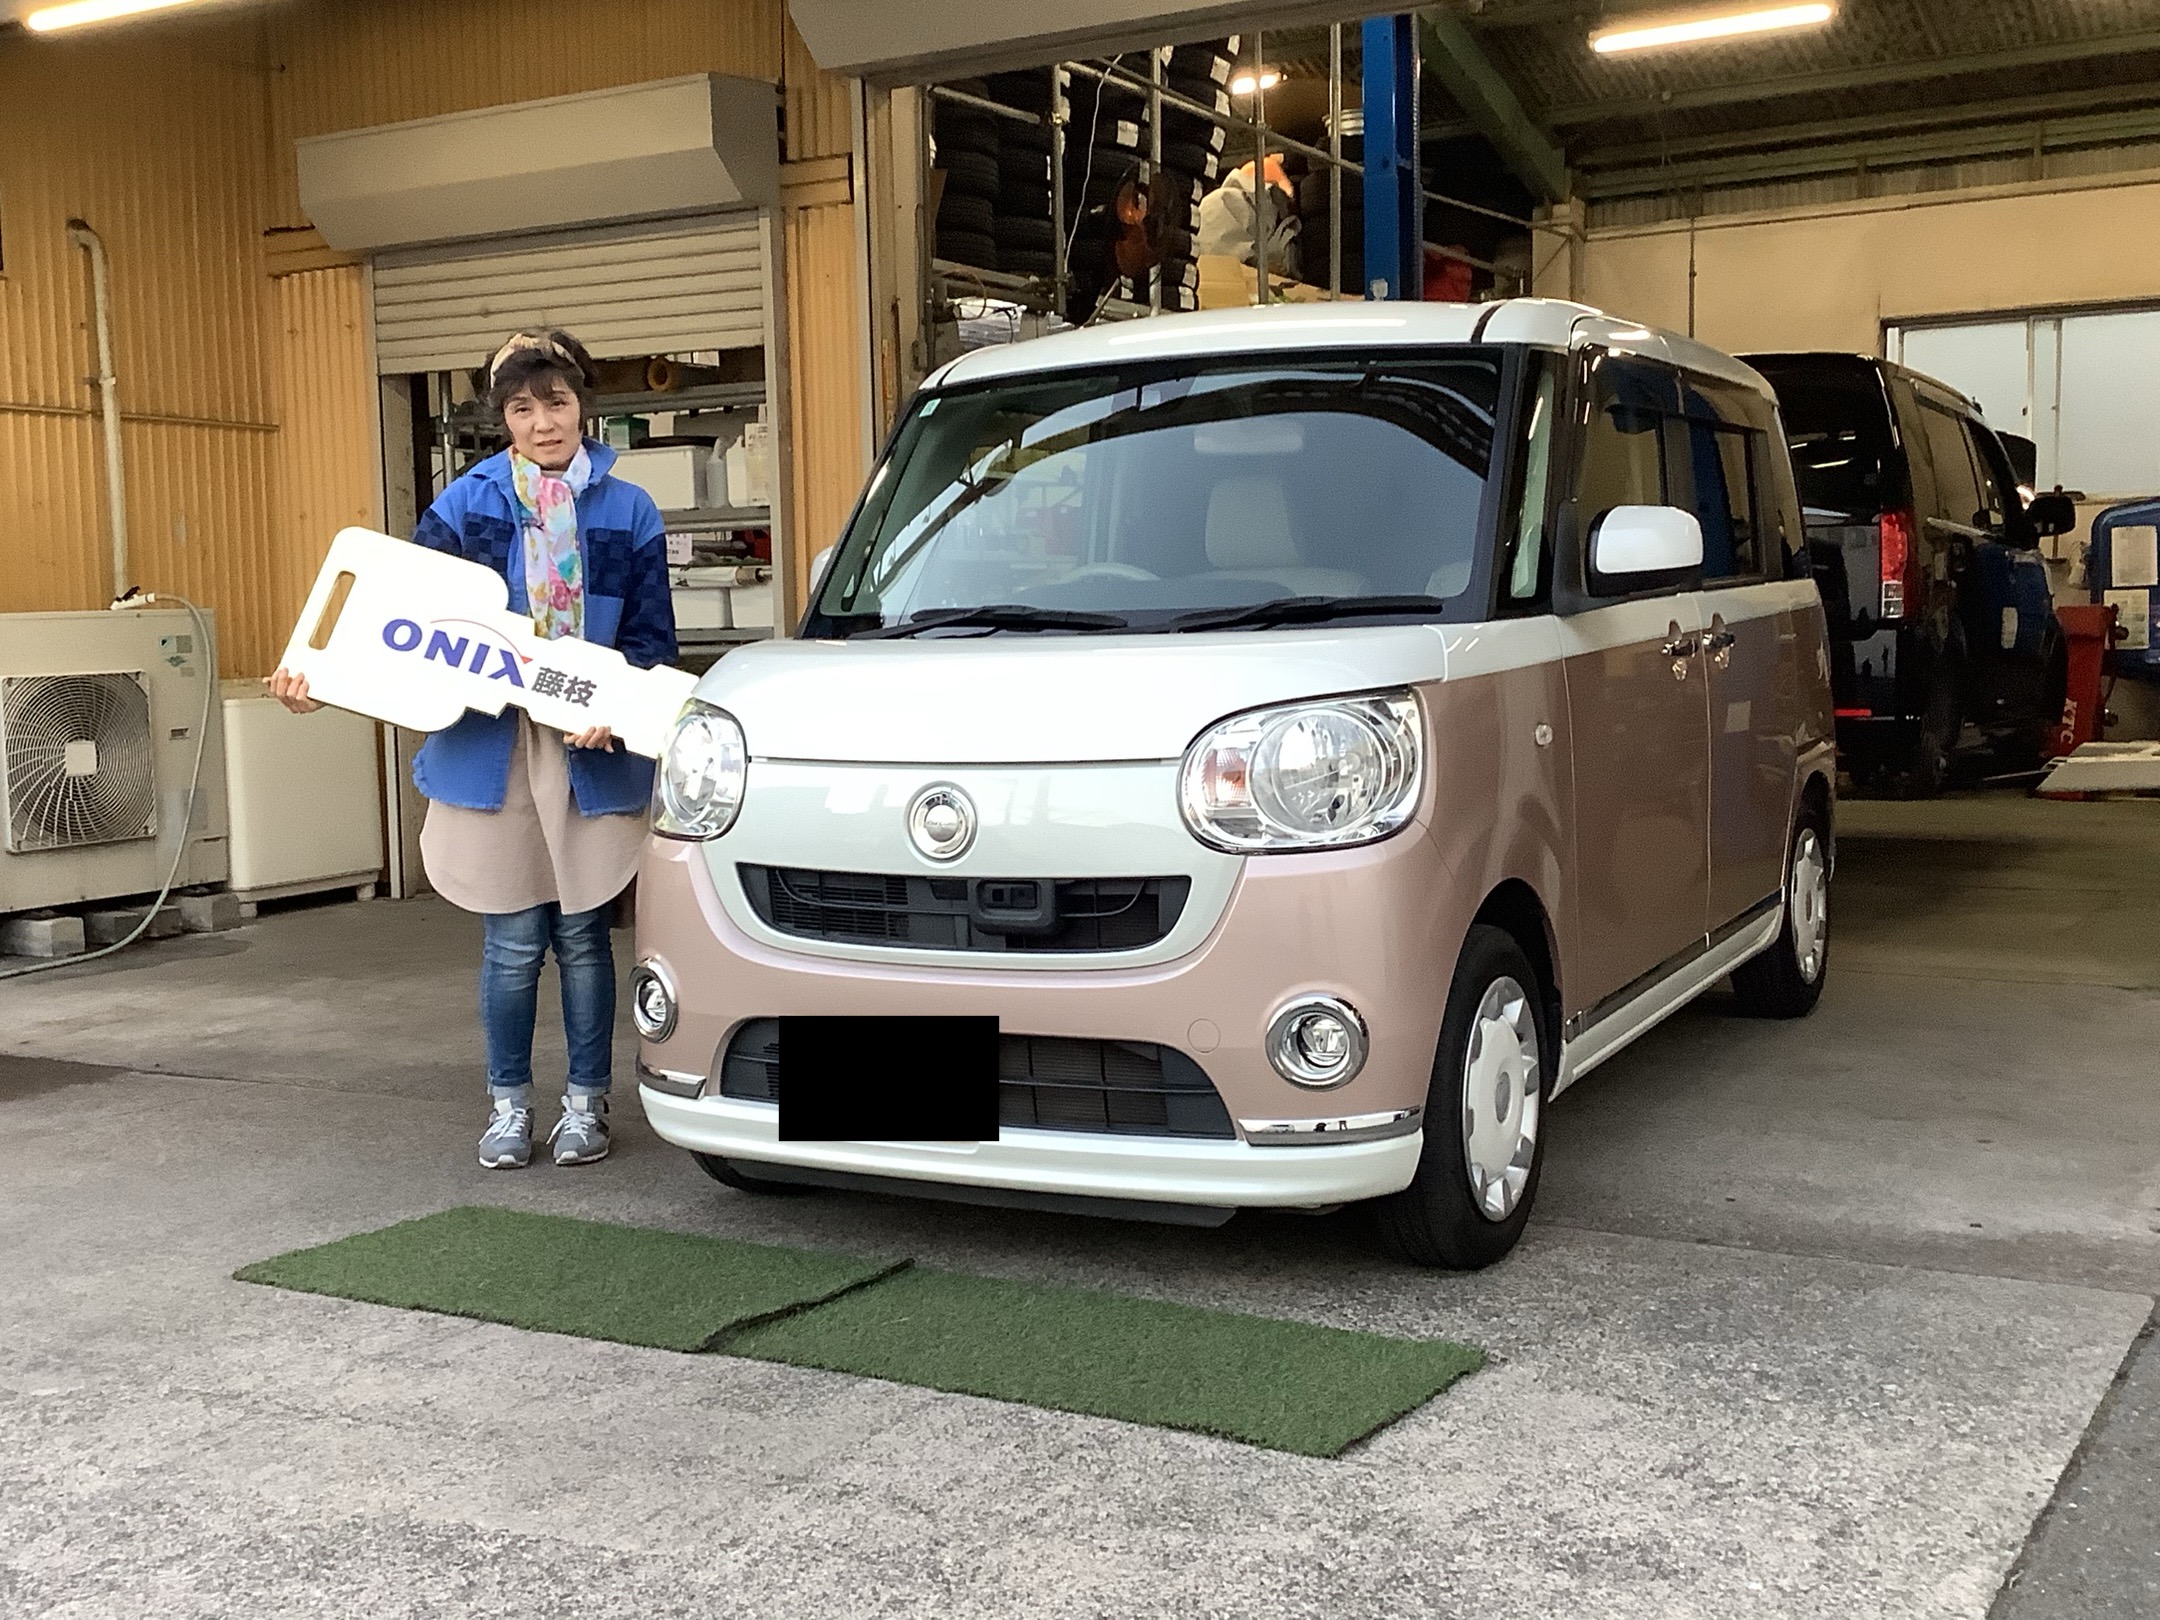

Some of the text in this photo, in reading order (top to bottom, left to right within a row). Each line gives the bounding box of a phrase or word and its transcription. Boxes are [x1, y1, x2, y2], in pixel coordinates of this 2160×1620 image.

[382, 618, 597, 708] ONIX 藤枝
[2060, 697, 2078, 745] KTC
